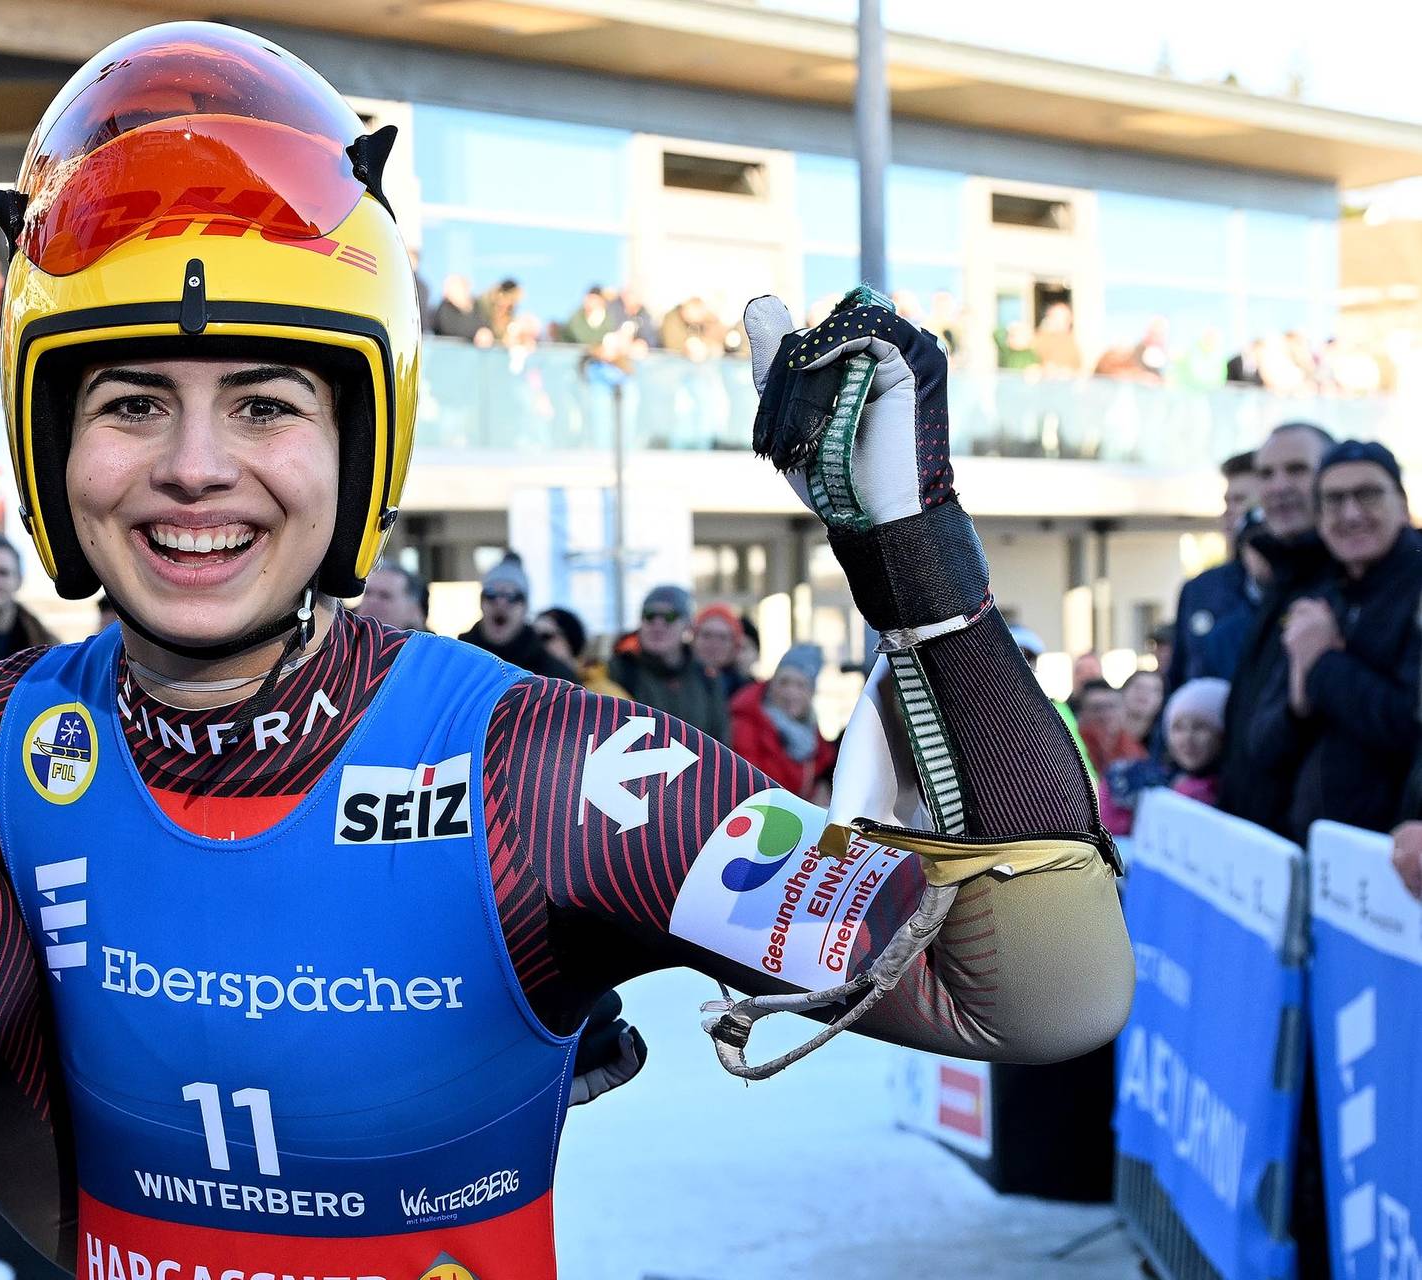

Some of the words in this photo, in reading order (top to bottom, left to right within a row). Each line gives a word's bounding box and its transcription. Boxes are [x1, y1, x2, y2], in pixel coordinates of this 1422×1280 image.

[52, 762, 76, 782] FIL
[825, 870, 884, 972] Chemnitz
[101, 945, 463, 1020] Eberspächer
[181, 1081, 281, 1177] 11
[134, 1170, 366, 1218] WINTERBERG
